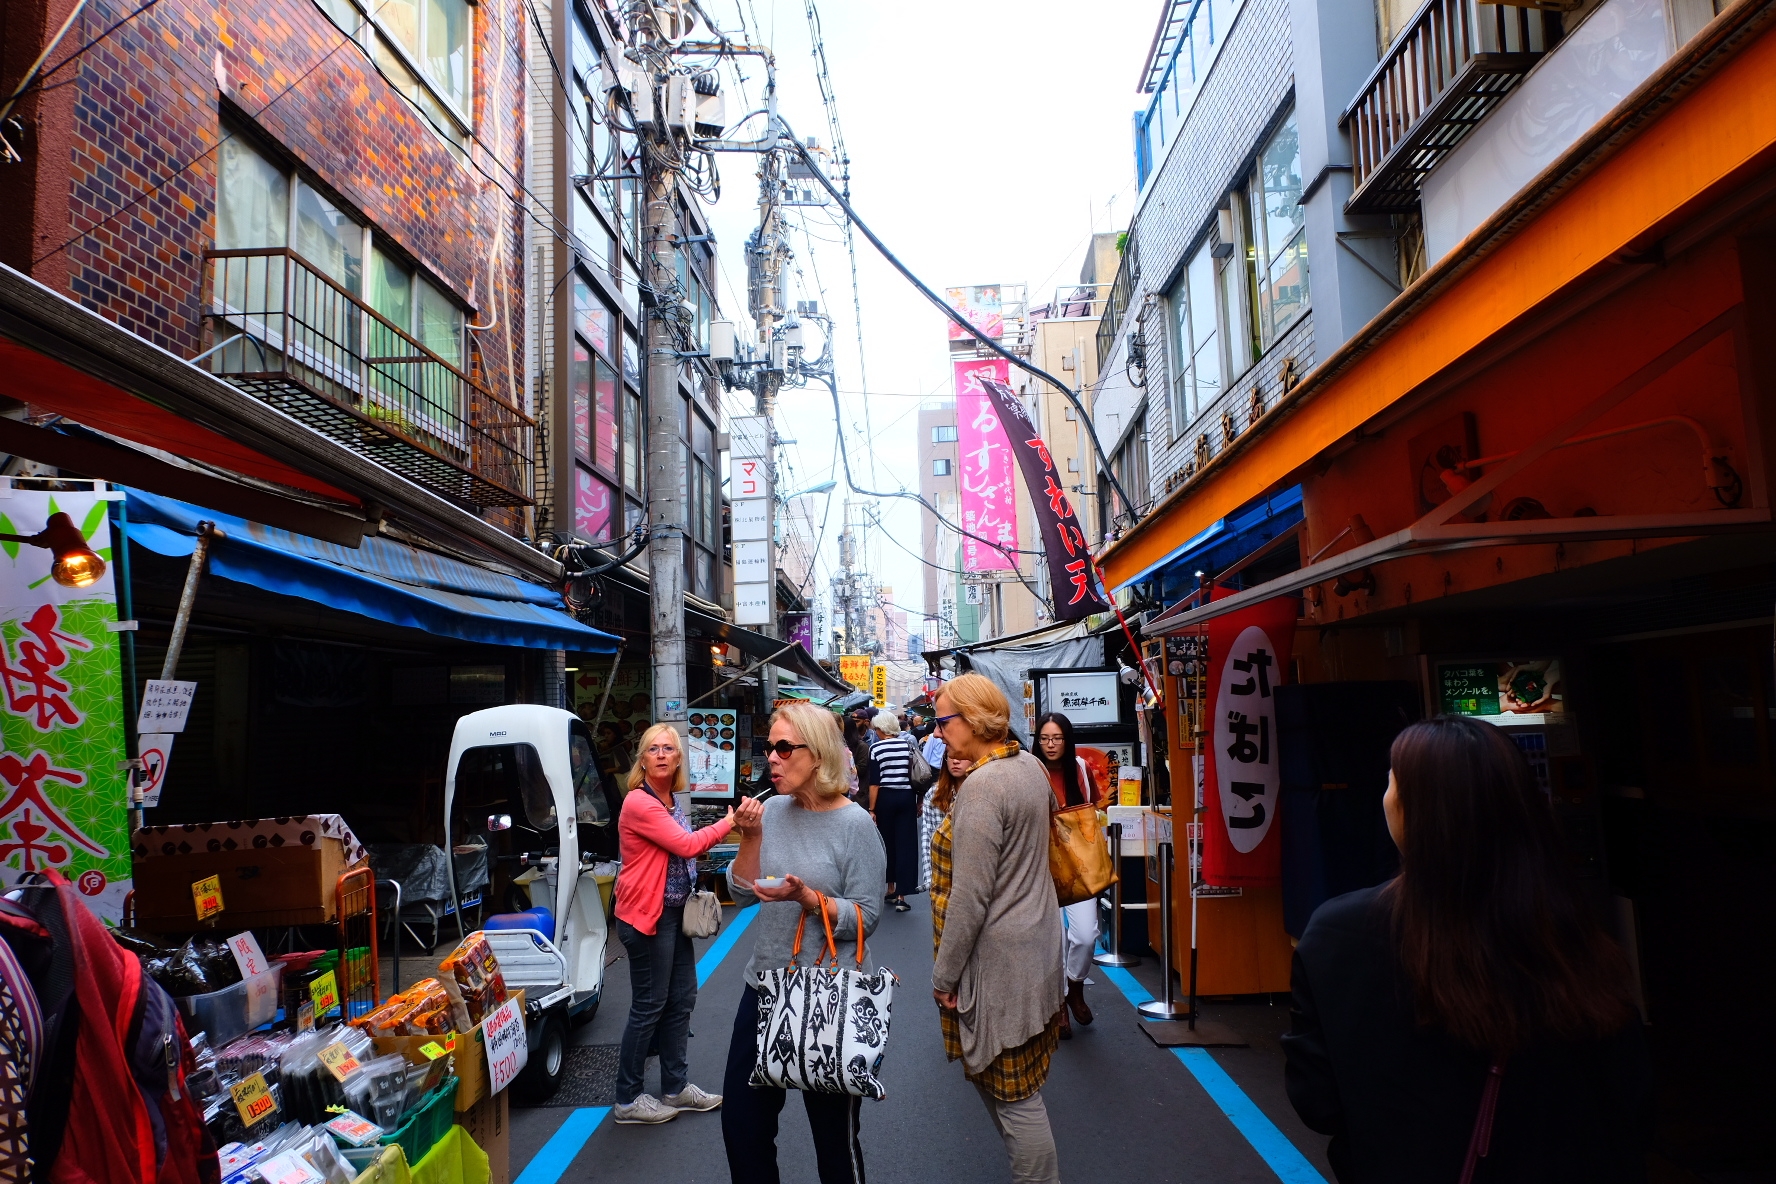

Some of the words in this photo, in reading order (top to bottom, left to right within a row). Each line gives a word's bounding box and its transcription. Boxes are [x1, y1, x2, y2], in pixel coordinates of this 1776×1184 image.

[742, 462, 756, 493] マコ
[1444, 668, 1485, 677] タバコ葉を
[1444, 679, 1469, 687] 味わう
[1445, 687, 1492, 696] メンソールを。
[1060, 696, 1107, 708] 魚河岸千両
[246, 1094, 273, 1119] 1500
